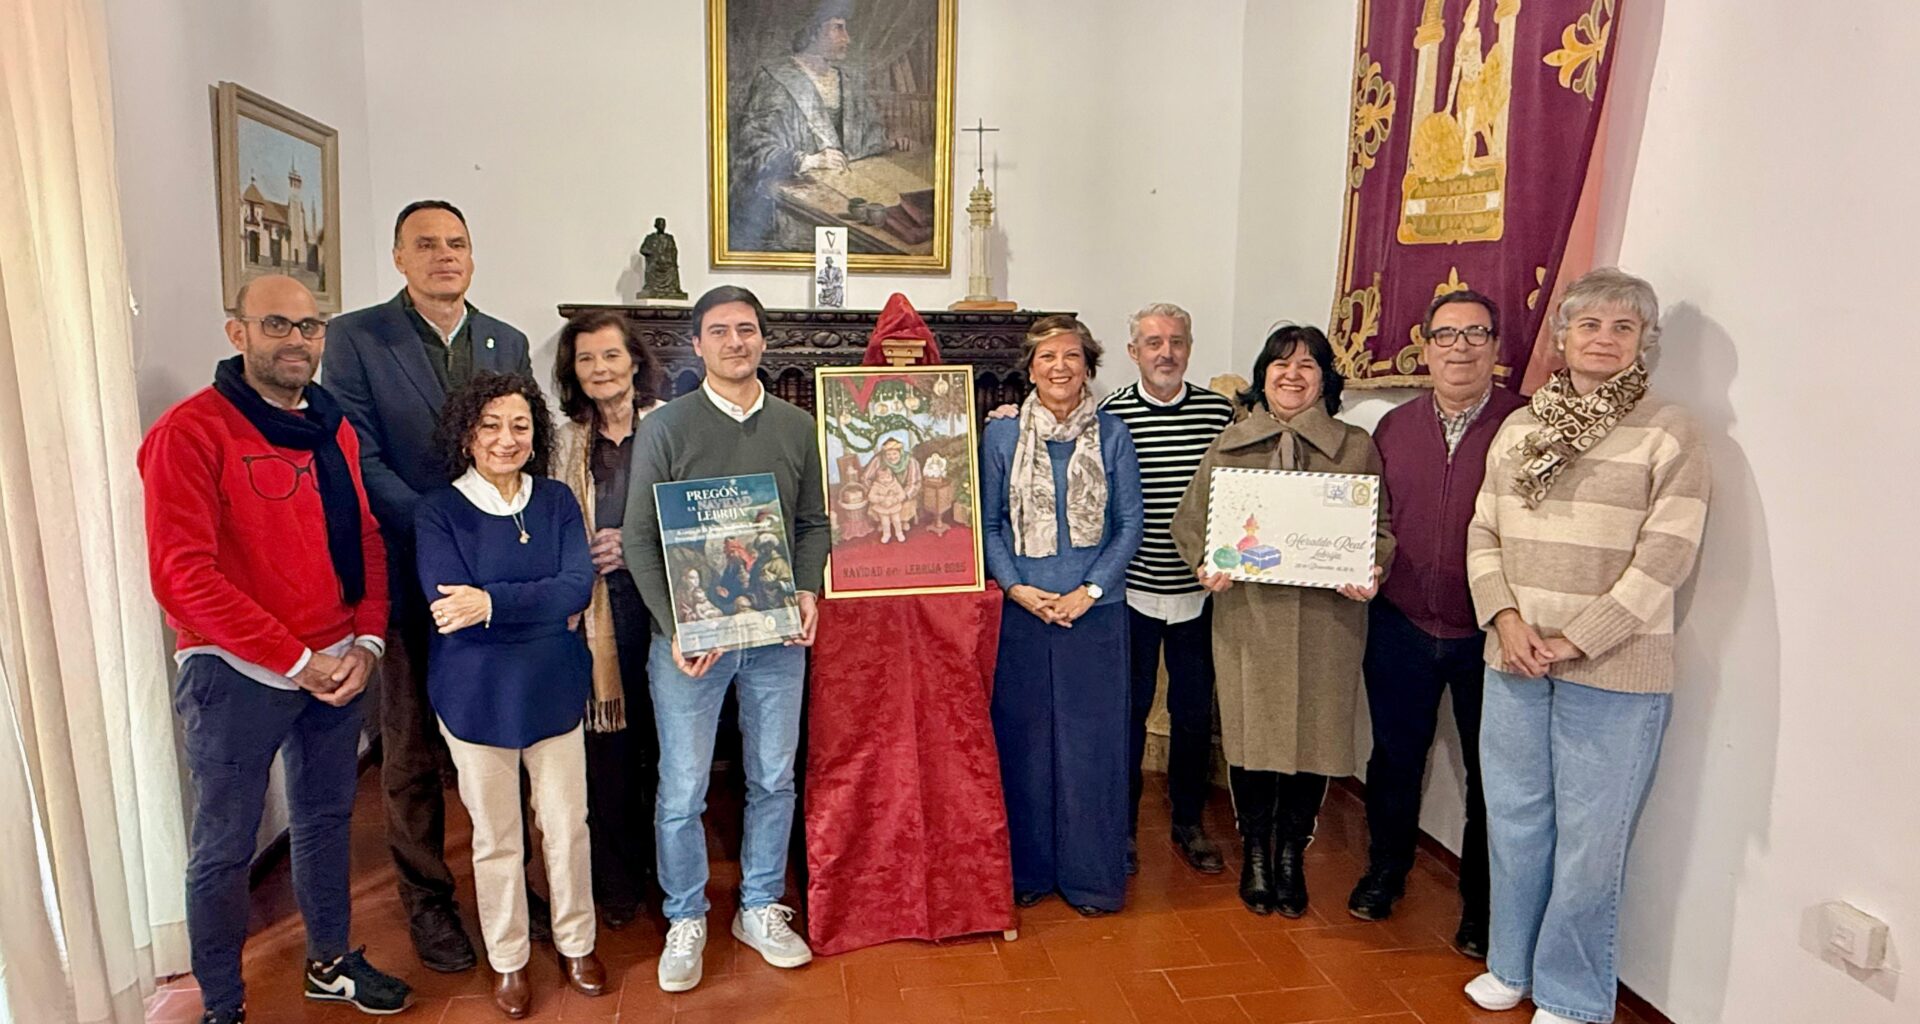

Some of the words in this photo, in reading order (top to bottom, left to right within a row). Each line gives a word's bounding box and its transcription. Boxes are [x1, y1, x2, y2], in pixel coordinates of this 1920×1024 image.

[686, 485, 738, 501] PREGÓN
[697, 495, 753, 511] NAVIDAD
[697, 507, 748, 522] LEBRIJA
[1333, 535, 1367, 553] Real
[843, 566, 883, 578] NAVIDAD
[905, 563, 942, 575] LEBRIJA
